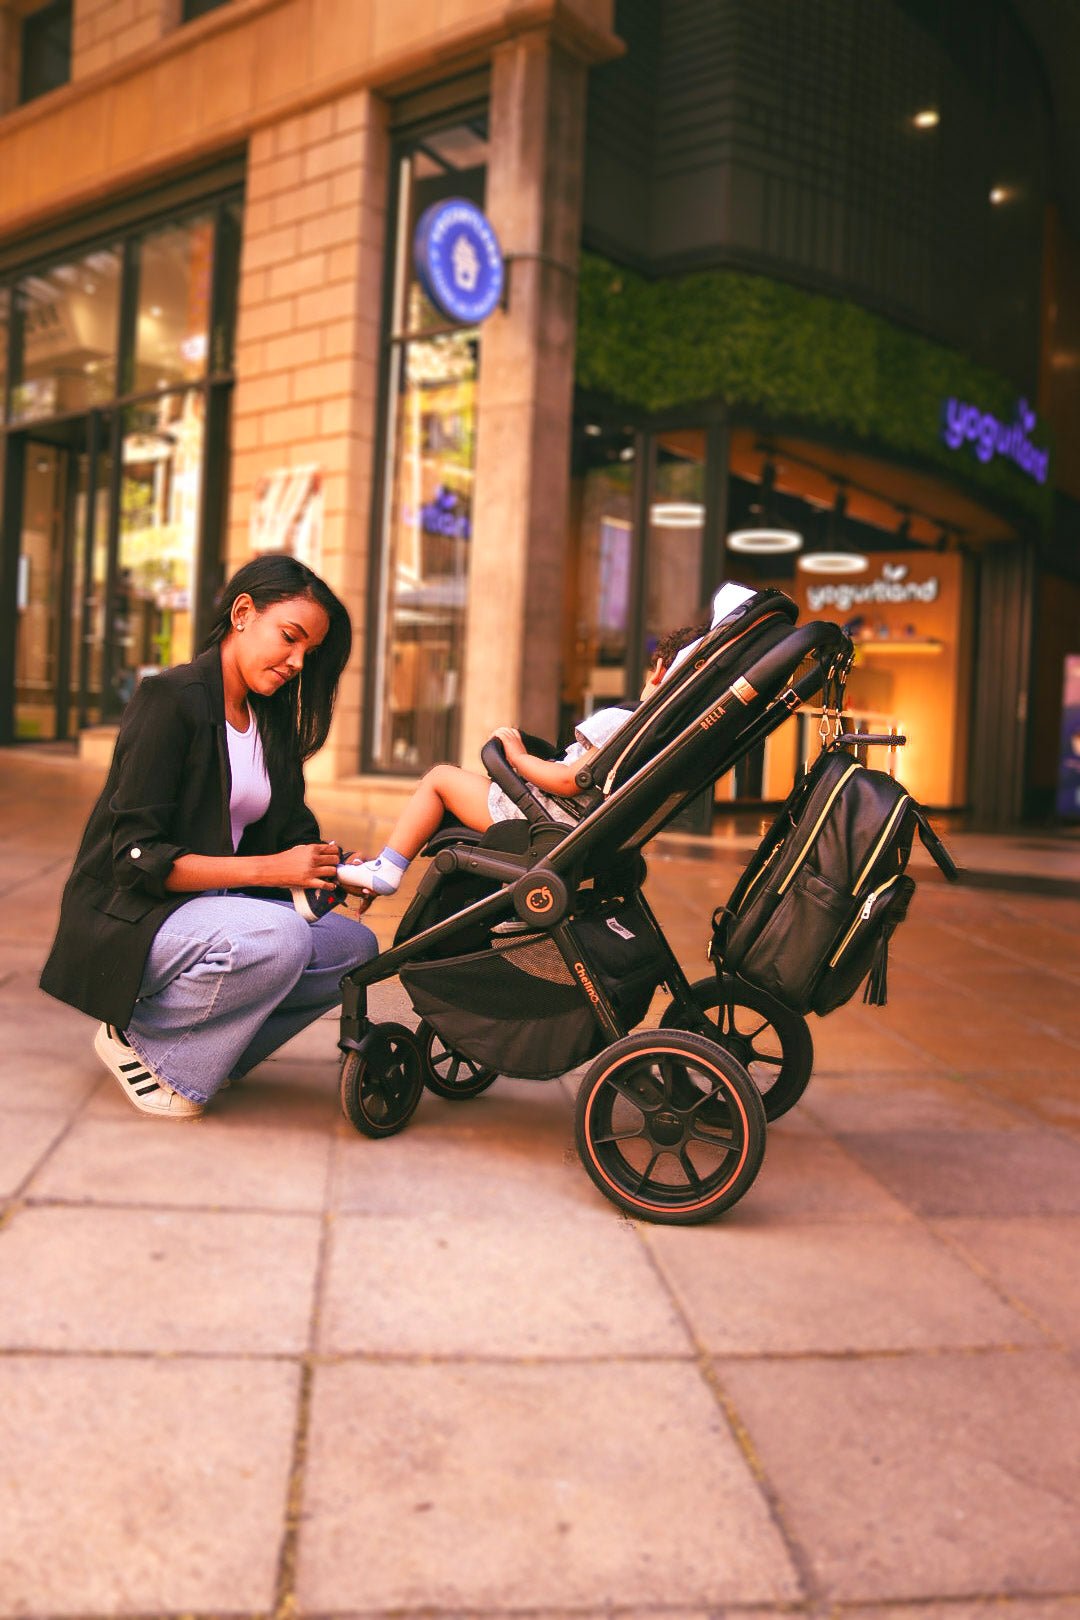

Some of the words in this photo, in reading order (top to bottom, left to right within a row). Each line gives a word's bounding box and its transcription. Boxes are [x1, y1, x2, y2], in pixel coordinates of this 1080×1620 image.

[806, 576, 938, 612] yogurtland
[700, 705, 727, 730] BELLA
[574, 961, 600, 1004] Chelino
